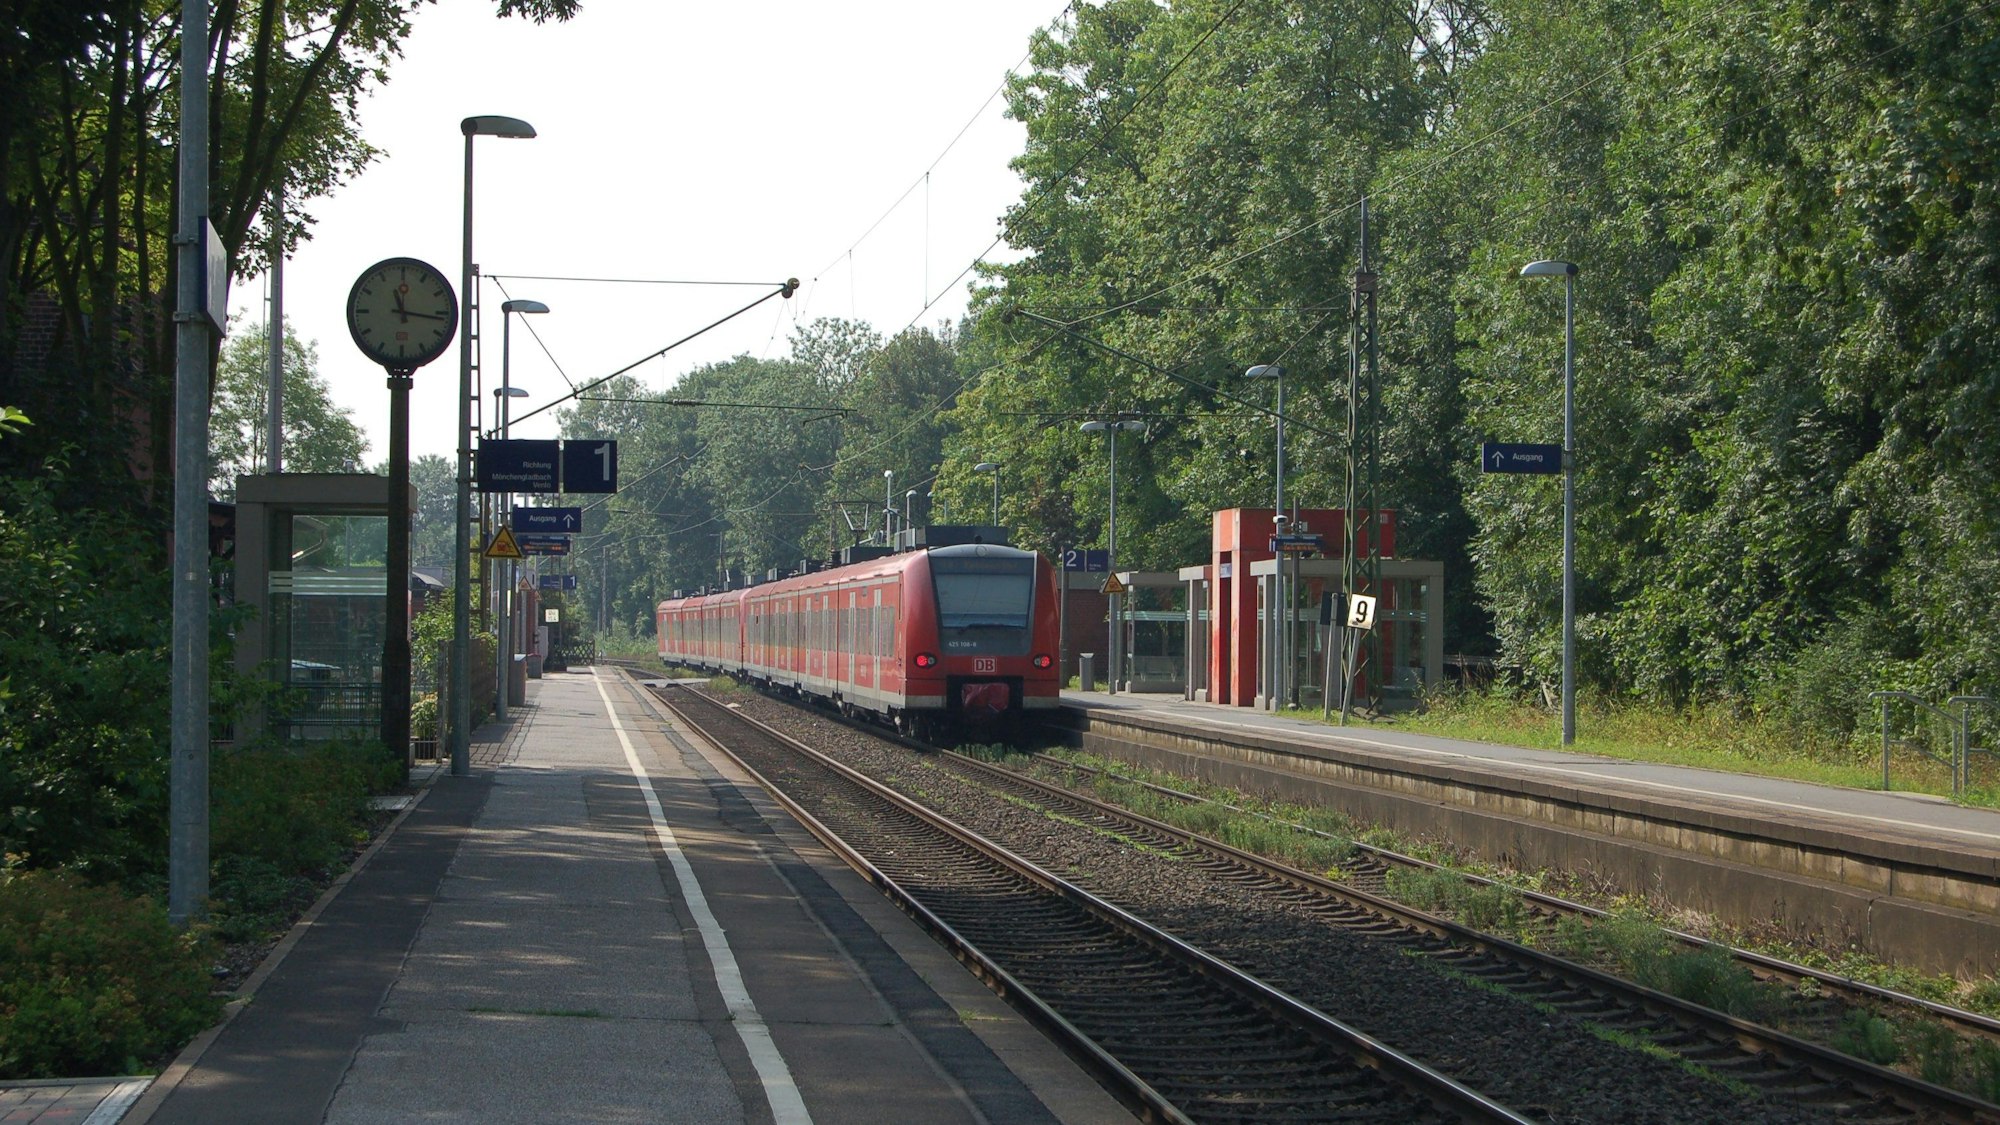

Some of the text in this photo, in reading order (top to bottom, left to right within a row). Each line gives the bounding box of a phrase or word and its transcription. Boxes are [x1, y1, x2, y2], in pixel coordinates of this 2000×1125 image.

[594, 442, 610, 481] 1
[1512, 452, 1543, 463] Ausgang
[522, 461, 552, 469] Richtung
[492, 473, 552, 481] Mönchengladbach
[532, 481, 551, 489] Venlo
[529, 514, 557, 523] Ausgang
[1066, 550, 1077, 567] 2
[570, 575, 576, 587] 1
[1355, 600, 1368, 623] 9
[975, 659, 994, 671] DB
